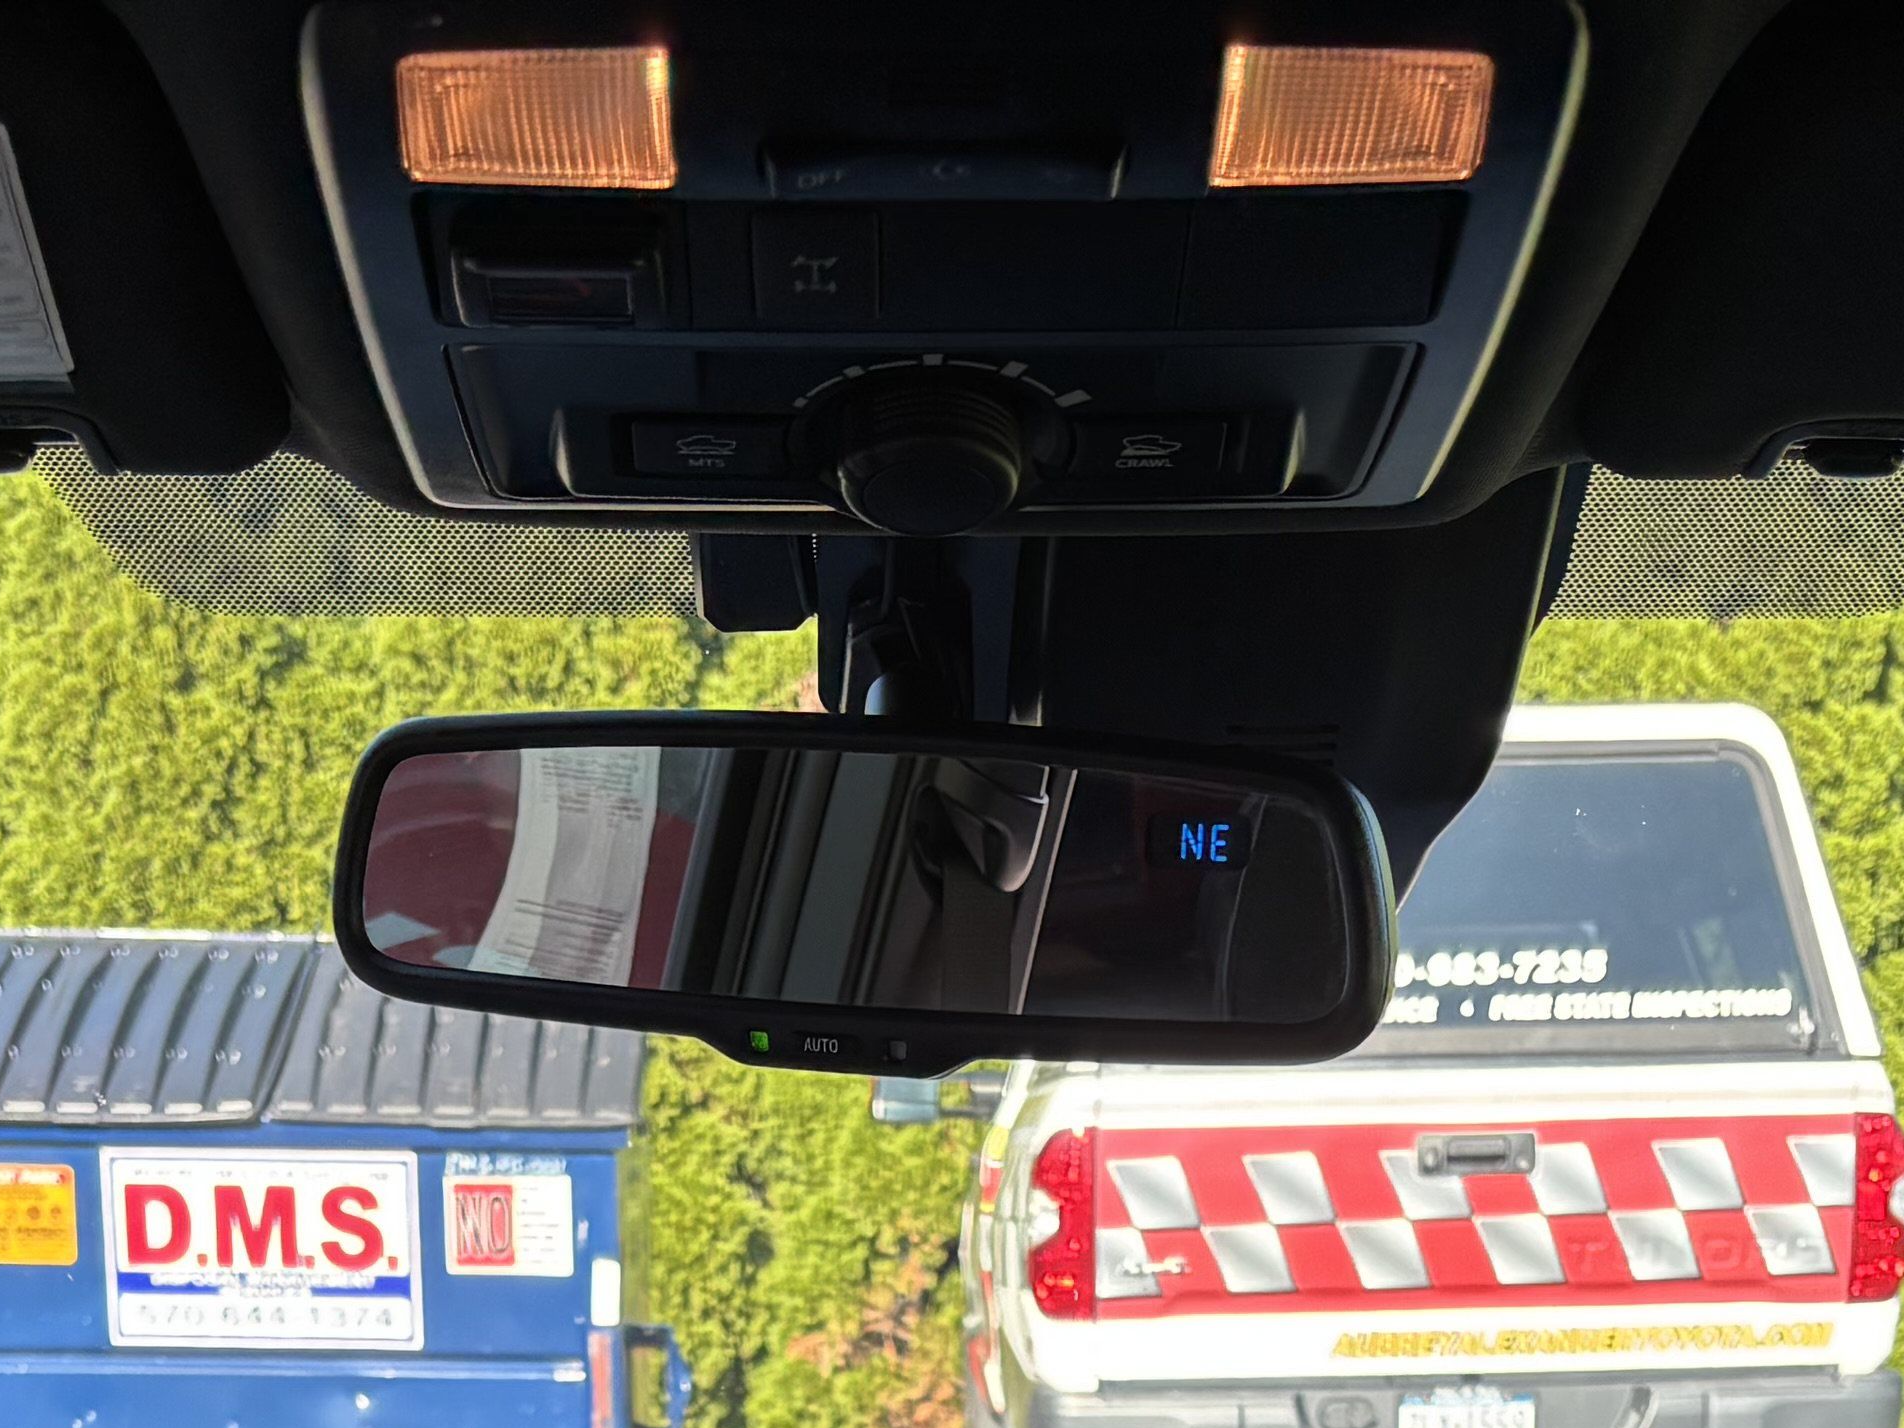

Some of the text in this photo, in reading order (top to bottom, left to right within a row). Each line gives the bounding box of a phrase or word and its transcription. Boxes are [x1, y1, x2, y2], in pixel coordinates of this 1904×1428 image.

[687, 456, 726, 470] MTS
[1114, 457, 1175, 469] CRAWL
[1177, 821, 1230, 864] NE
[802, 1036, 839, 1054] AUTO
[123, 1183, 400, 1272] D.M.S.
